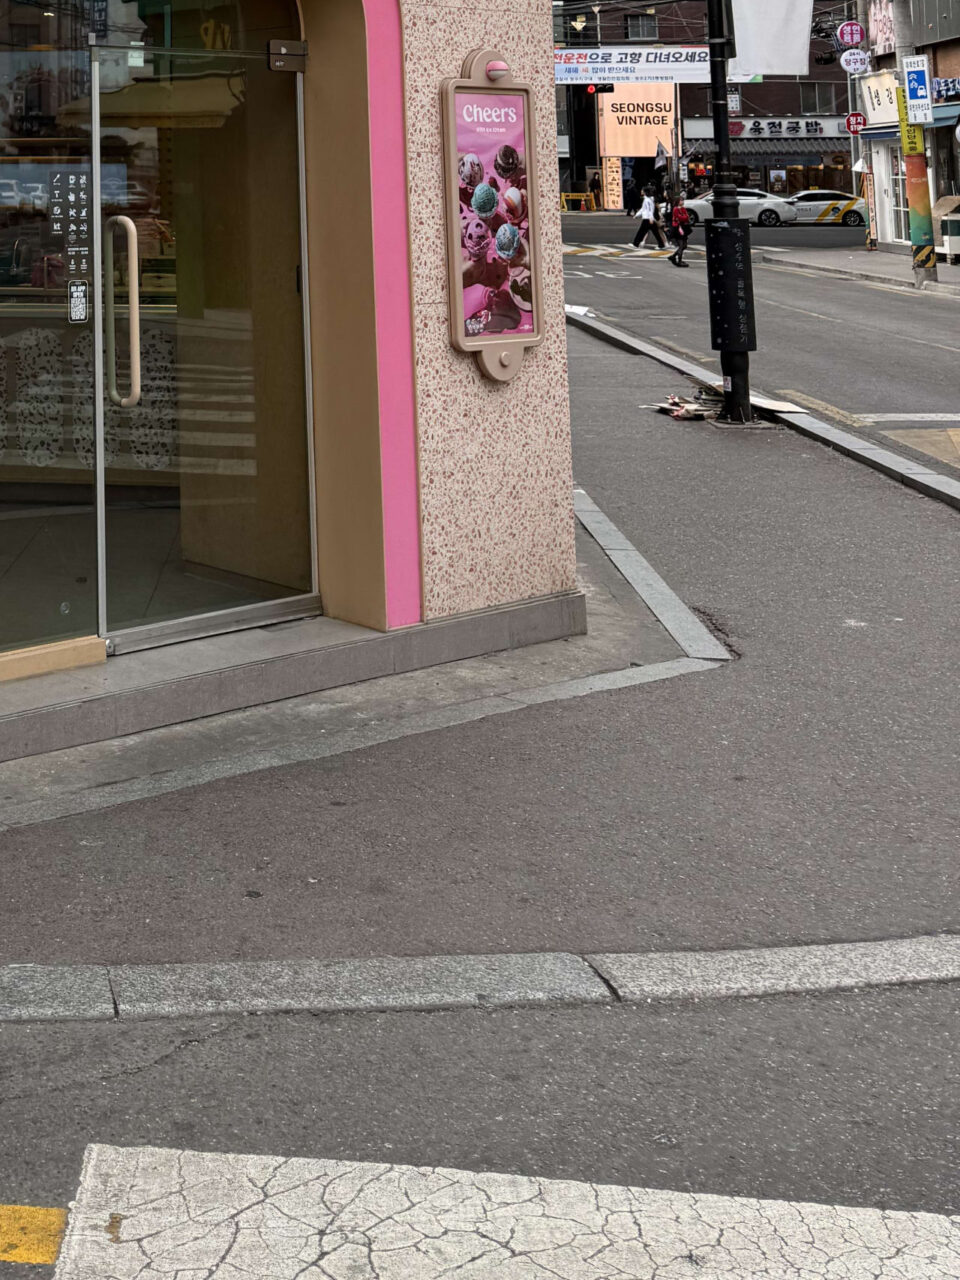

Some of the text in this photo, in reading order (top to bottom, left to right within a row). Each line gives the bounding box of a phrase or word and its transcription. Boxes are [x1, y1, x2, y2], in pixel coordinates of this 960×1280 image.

[616, 52, 642, 64] 고향
[645, 51, 710, 63] 다녀오세요
[844, 57, 866, 66] 당구장
[592, 66, 606, 74] 많이
[610, 102, 672, 113] SEONGSU
[462, 104, 517, 123] Cheers
[616, 115, 669, 126] VINTAGE
[849, 116, 864, 124] 정지
[749, 120, 821, 136] 육전국밥
[849, 124, 864, 132] STOP
